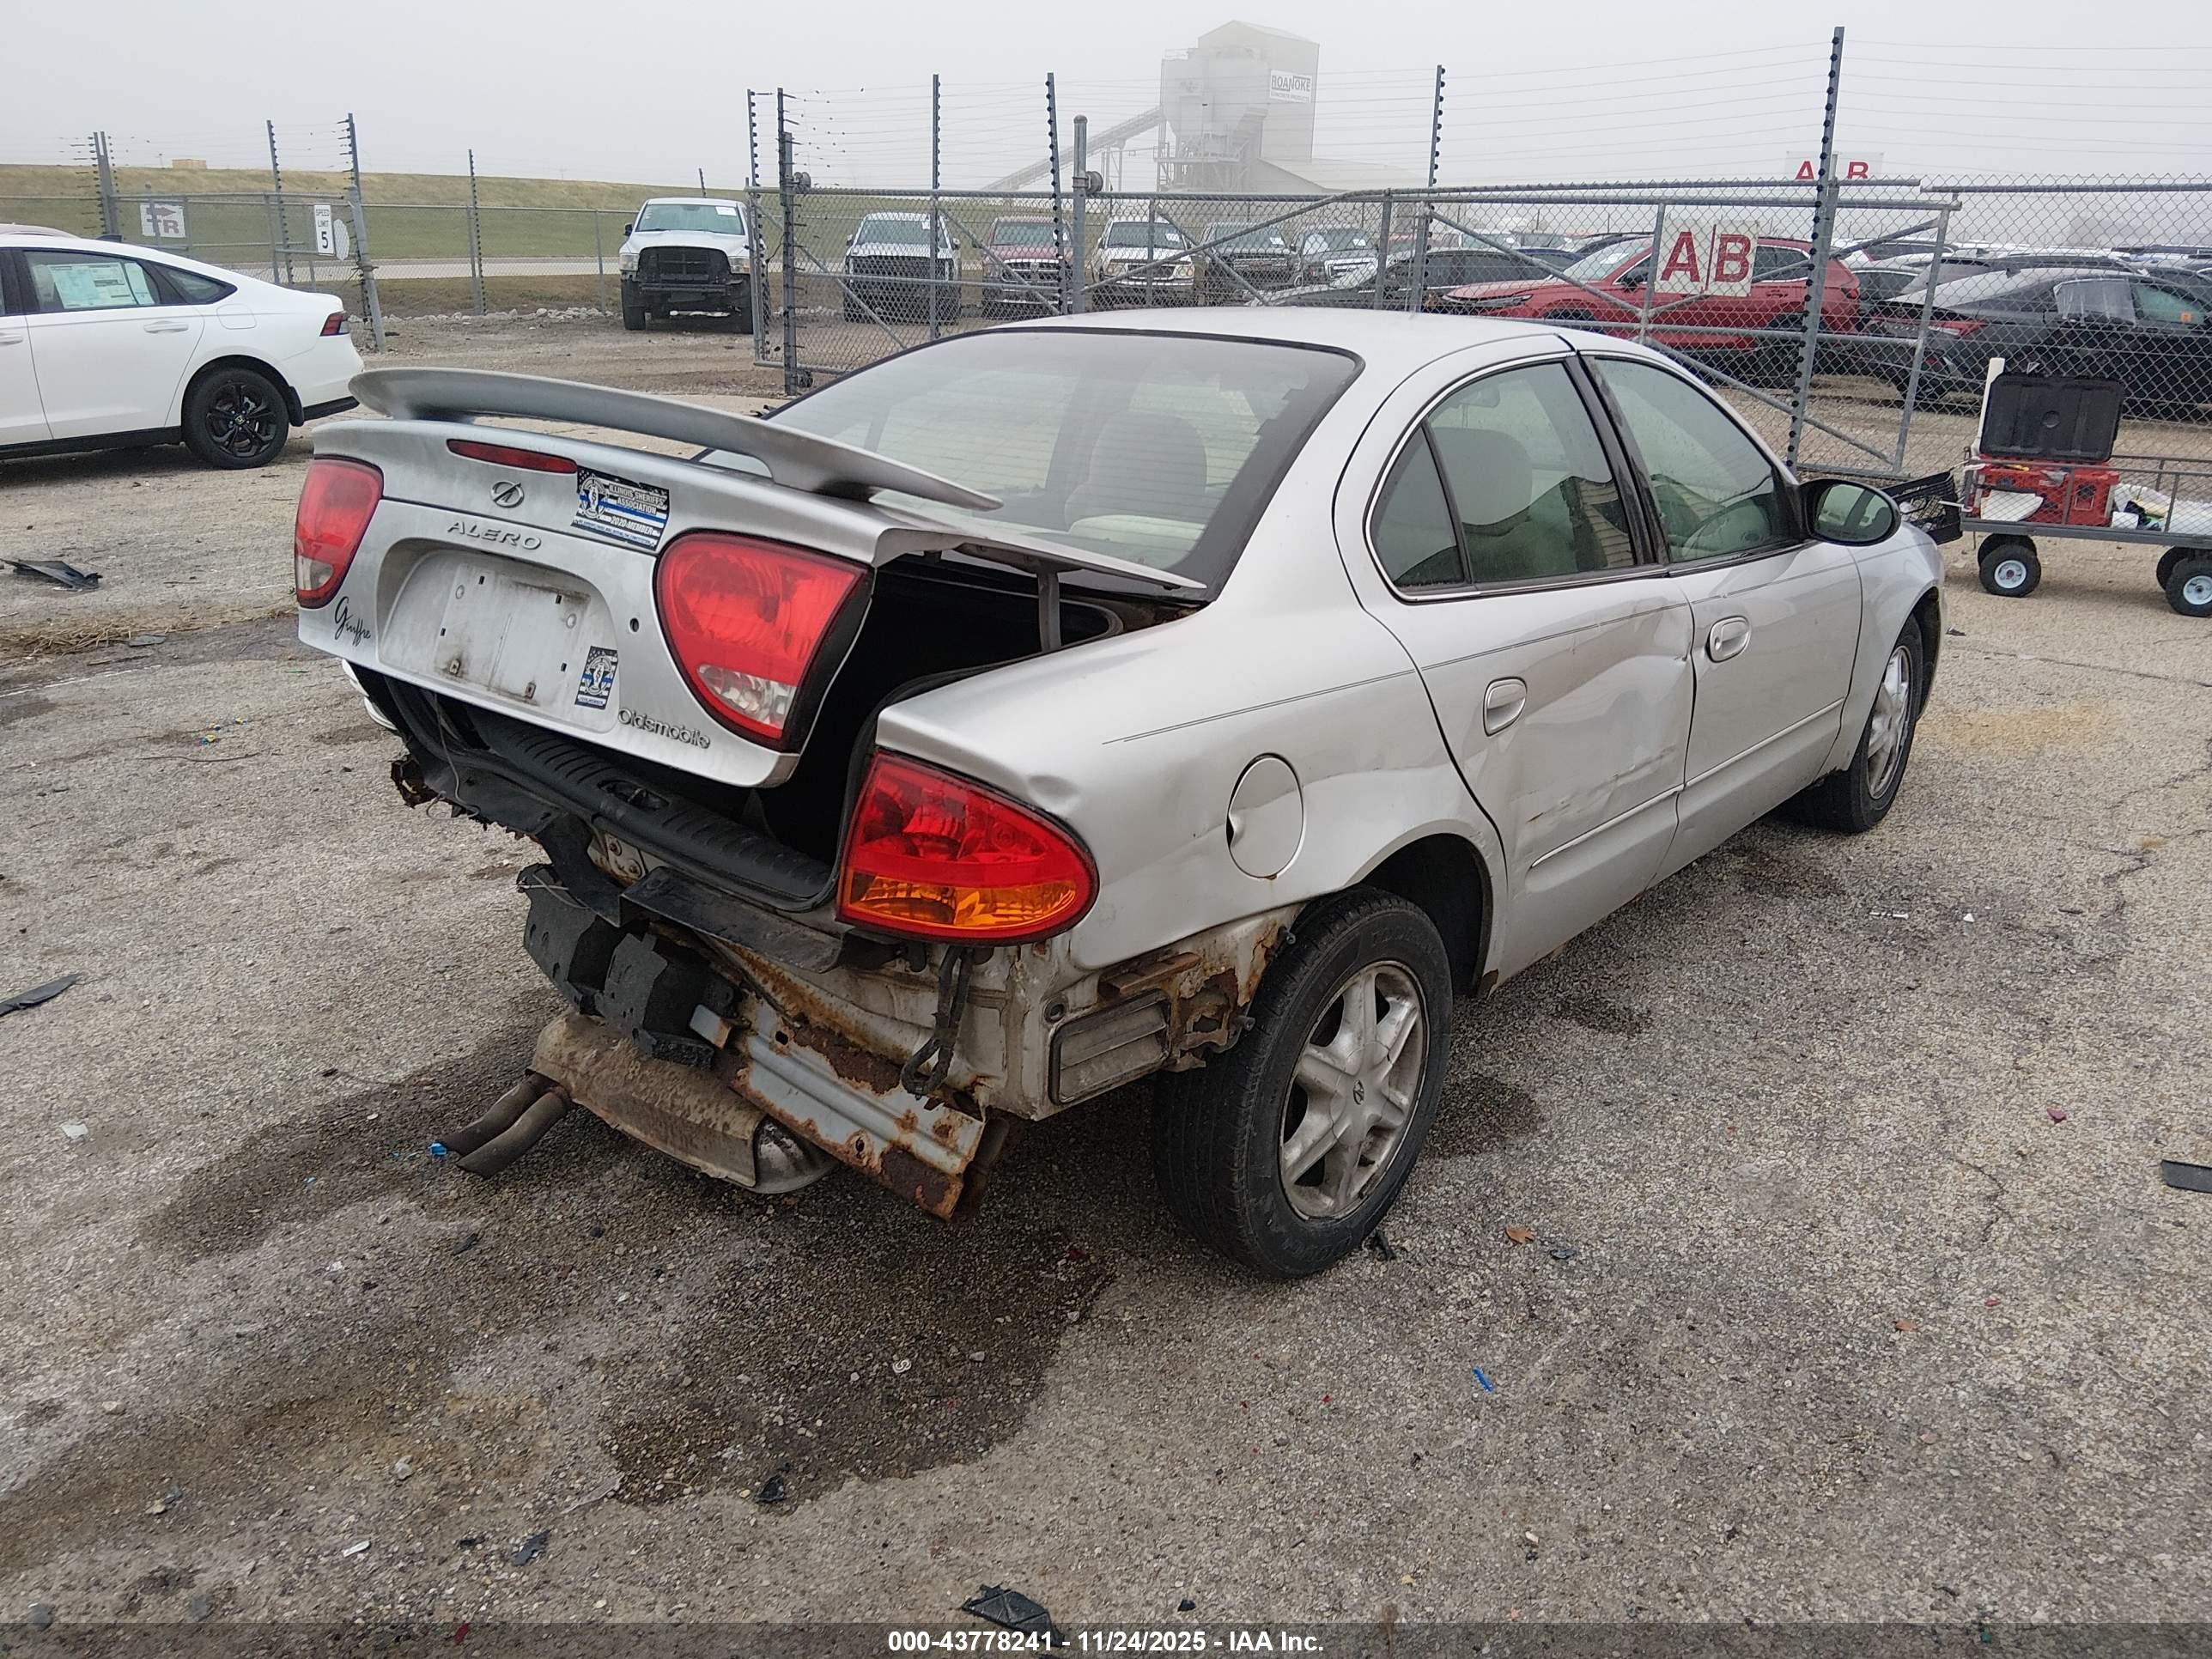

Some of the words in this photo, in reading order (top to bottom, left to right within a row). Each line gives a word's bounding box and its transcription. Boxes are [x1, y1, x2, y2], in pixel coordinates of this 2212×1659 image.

[1271, 75, 1311, 92] ROANOKE
[321, 231, 329, 249] 5
[1660, 231, 1700, 283] A
[1714, 234, 1751, 283] B
[608, 483, 634, 498] ILLINOIS
[617, 496, 657, 515] ASSOCIATION
[447, 521, 542, 550] ALERO
[611, 515, 626, 528] 2020
[626, 520, 653, 536] MEMBER
[618, 707, 711, 750] Oldsmobile
